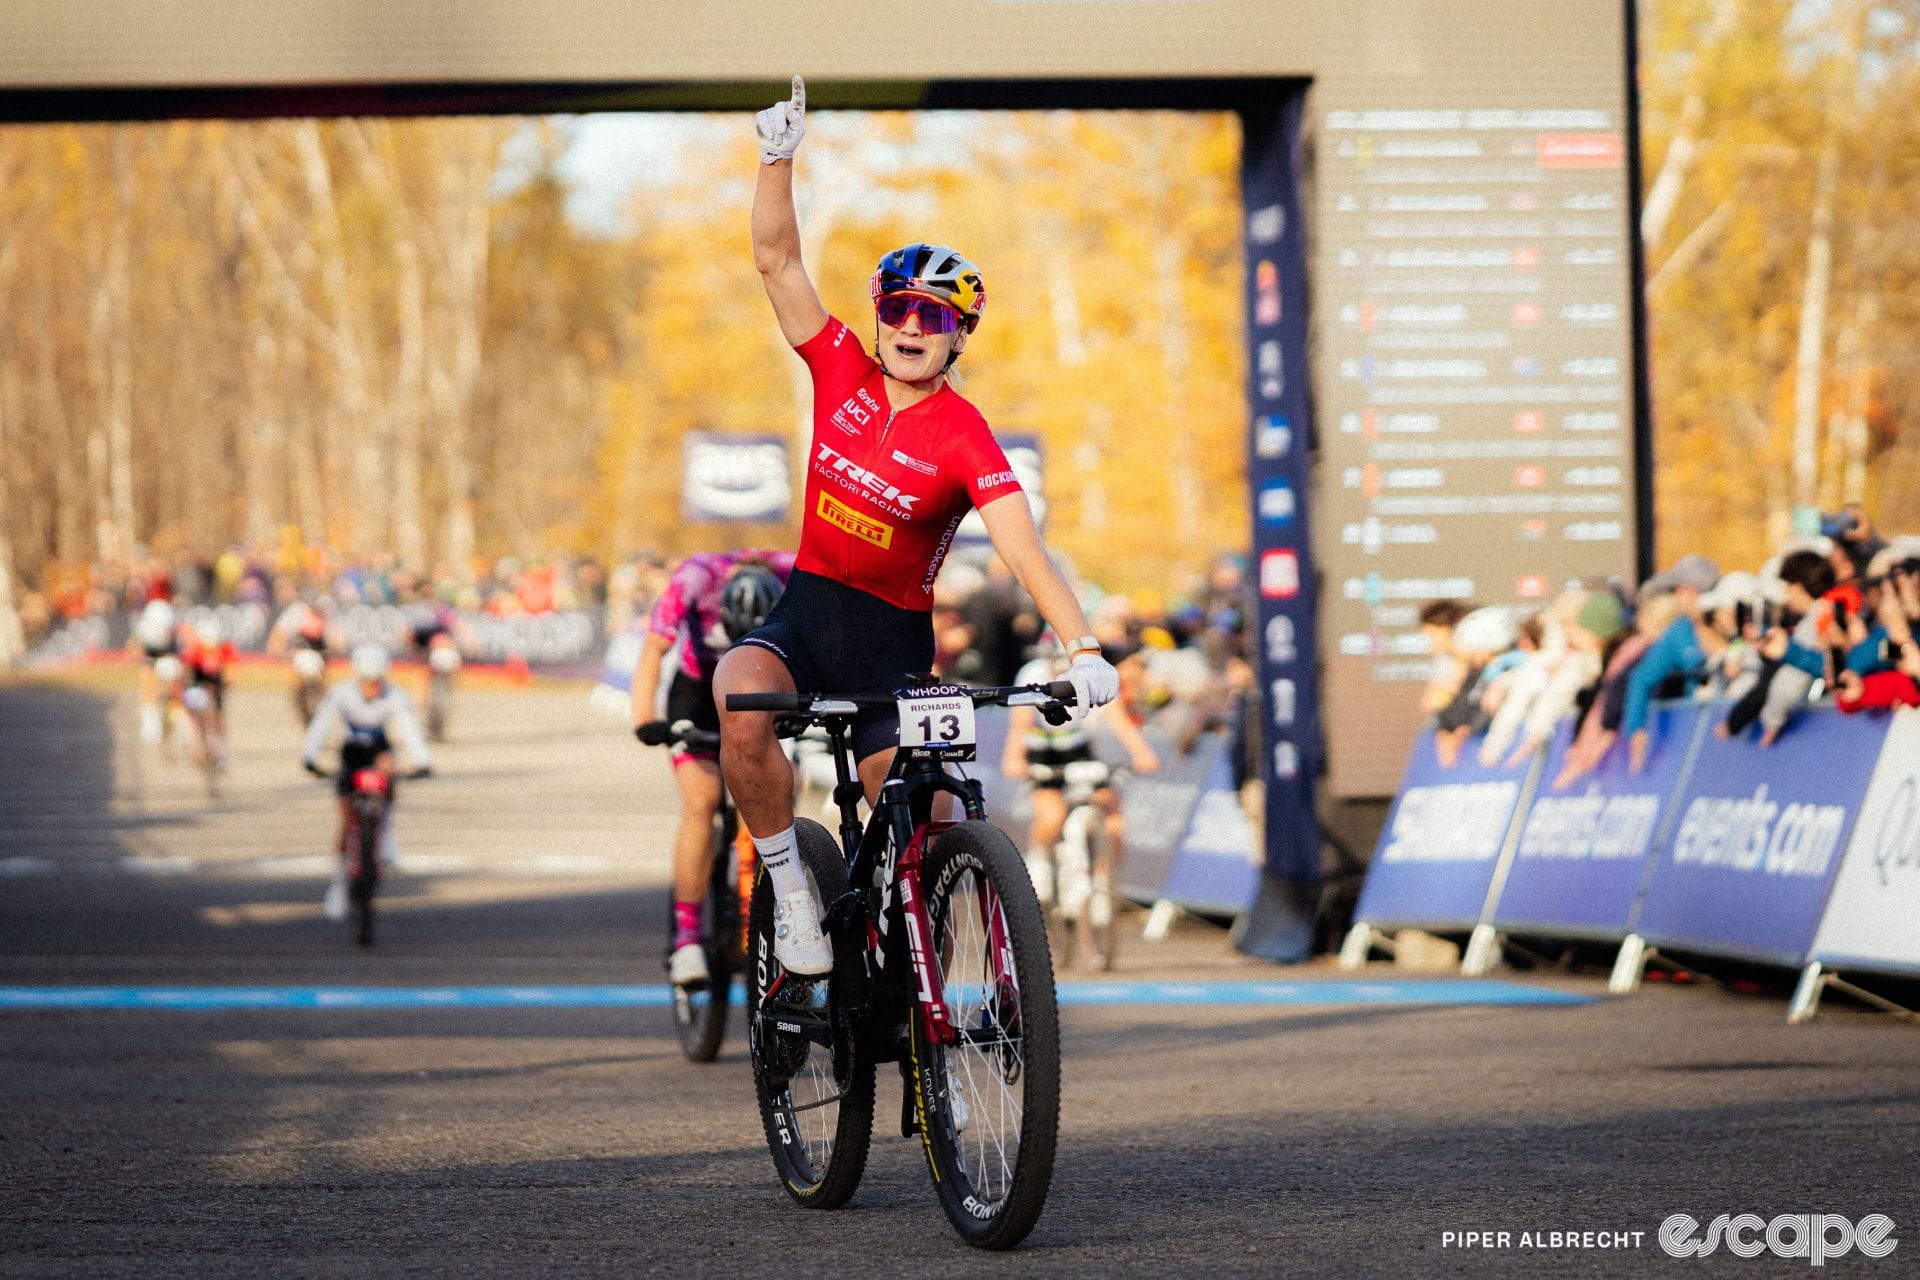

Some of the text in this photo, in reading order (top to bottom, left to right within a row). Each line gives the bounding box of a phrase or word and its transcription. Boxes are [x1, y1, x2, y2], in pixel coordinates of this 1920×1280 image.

[844, 398, 871, 426] UCI
[814, 462, 862, 496] FACTORY
[861, 489, 912, 521] RACING
[817, 442, 921, 511] TREK
[822, 498, 885, 543] PIRELLI
[925, 516, 961, 582] unbroken
[907, 685, 959, 698] WHOOP
[911, 702, 962, 712] RICHARDS
[918, 714, 961, 742] 13
[1673, 783, 1845, 876] events.com
[776, 1021, 801, 1034] SRAM
[923, 1067, 937, 1113] KOVEE
